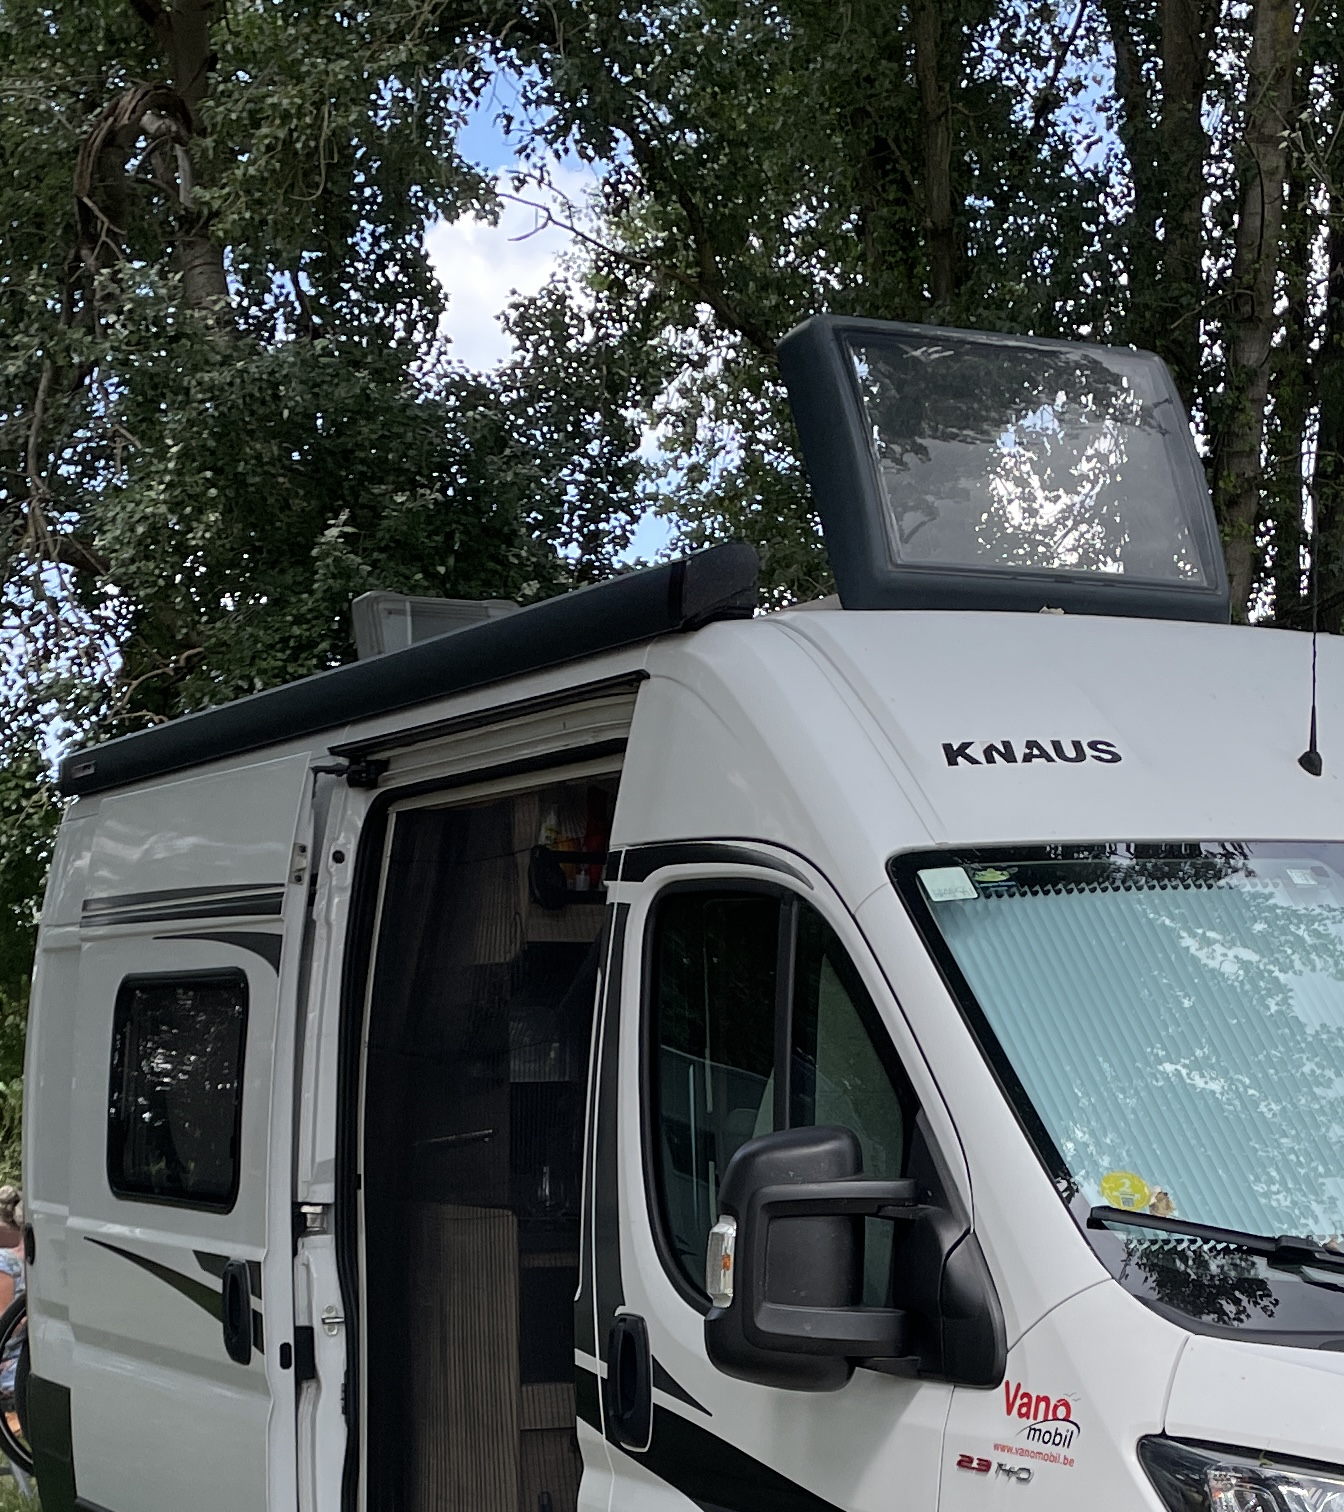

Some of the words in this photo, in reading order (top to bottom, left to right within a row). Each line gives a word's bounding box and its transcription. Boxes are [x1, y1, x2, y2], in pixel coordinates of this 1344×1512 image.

[941, 739, 1123, 766] KNAUS
[1004, 1379, 1072, 1421] Vano
[1026, 1425, 1074, 1449] mobil
[993, 1442, 1075, 1468] www.vanomobil.be
